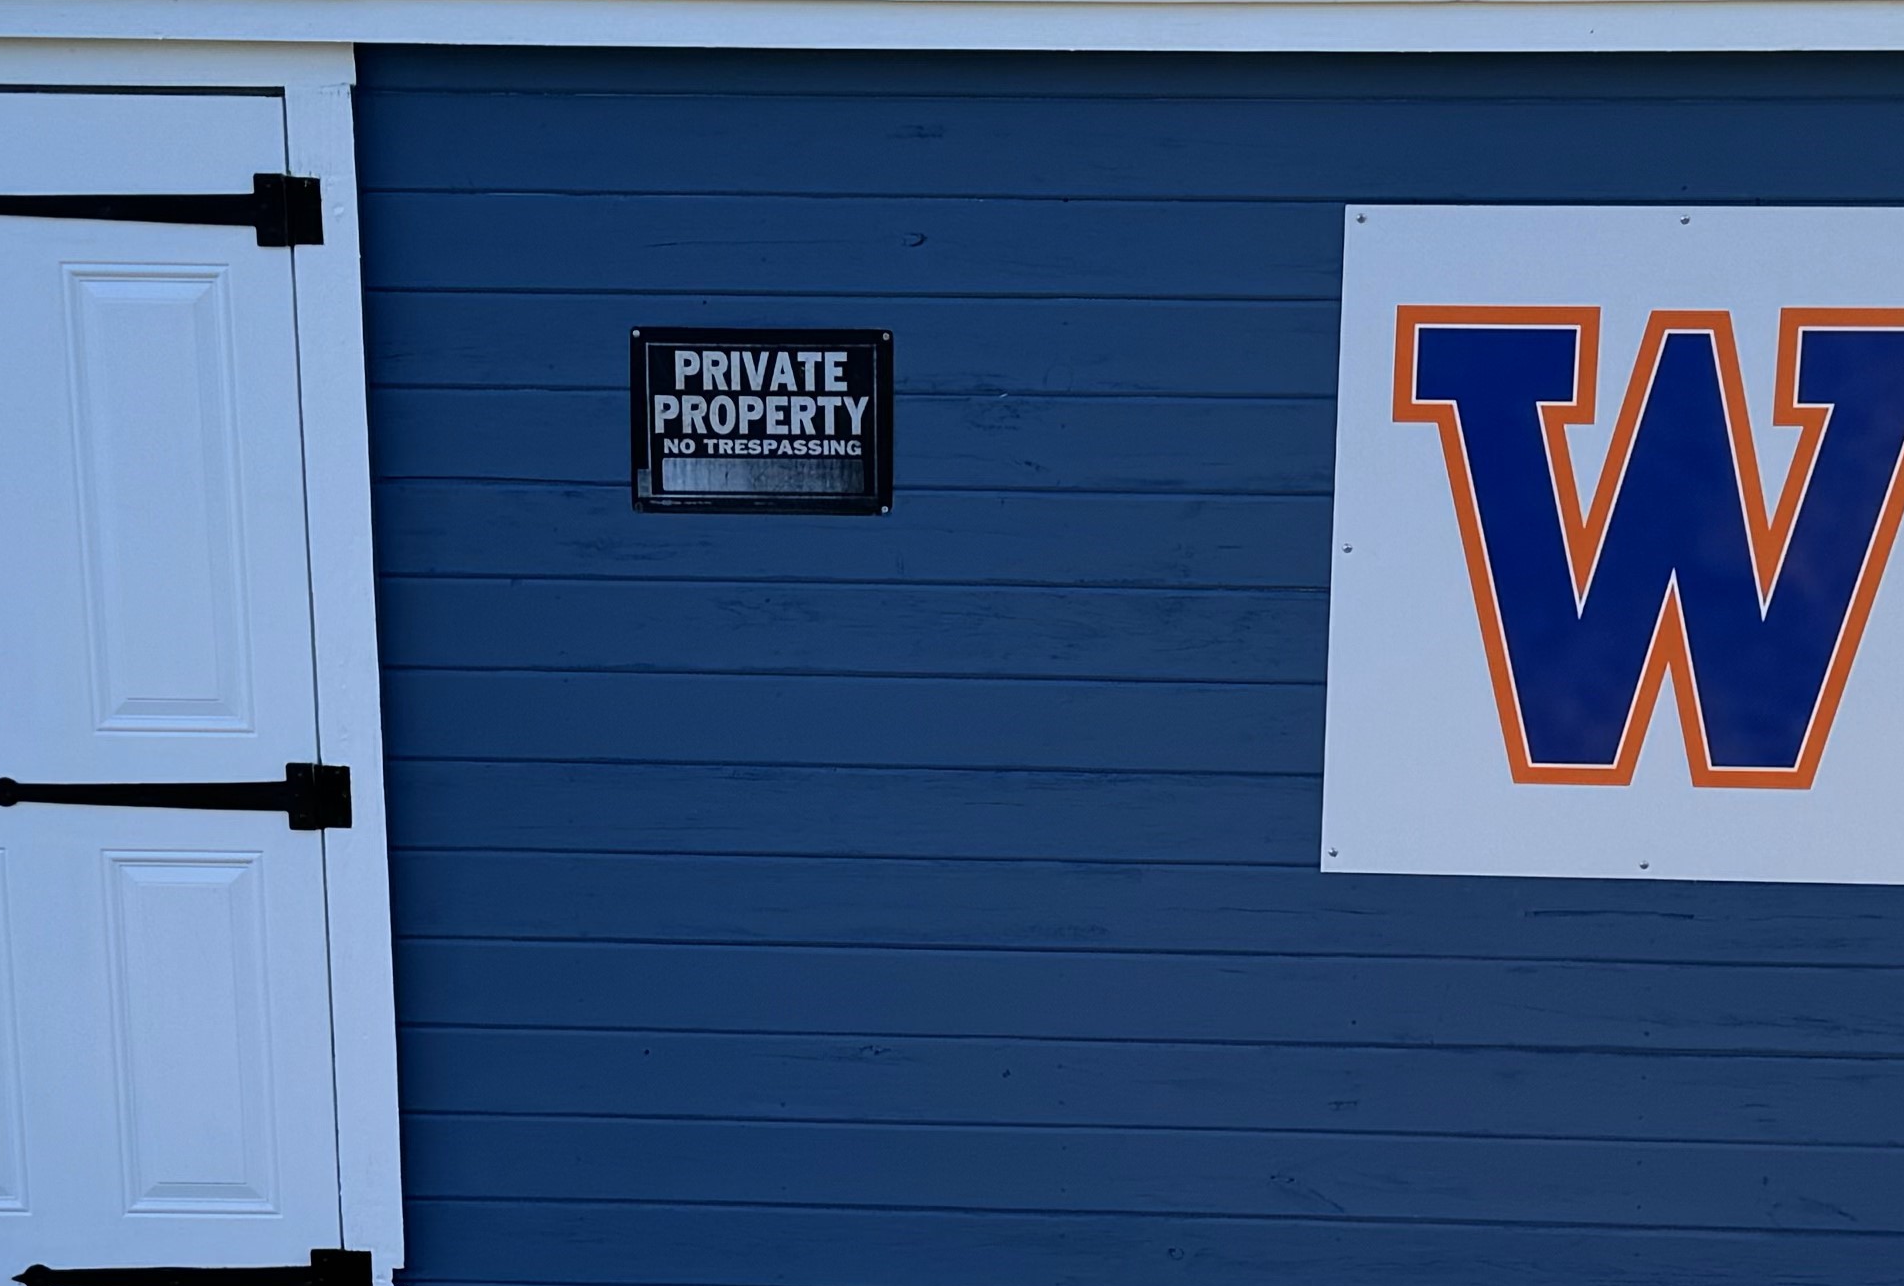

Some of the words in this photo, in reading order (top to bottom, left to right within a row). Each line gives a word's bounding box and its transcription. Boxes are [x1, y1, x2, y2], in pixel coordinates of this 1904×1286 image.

[674, 350, 848, 391] PRIVATE
[654, 395, 870, 435] PROPERTY
[663, 438, 696, 454] NO
[703, 439, 862, 456] TRESPASSING
